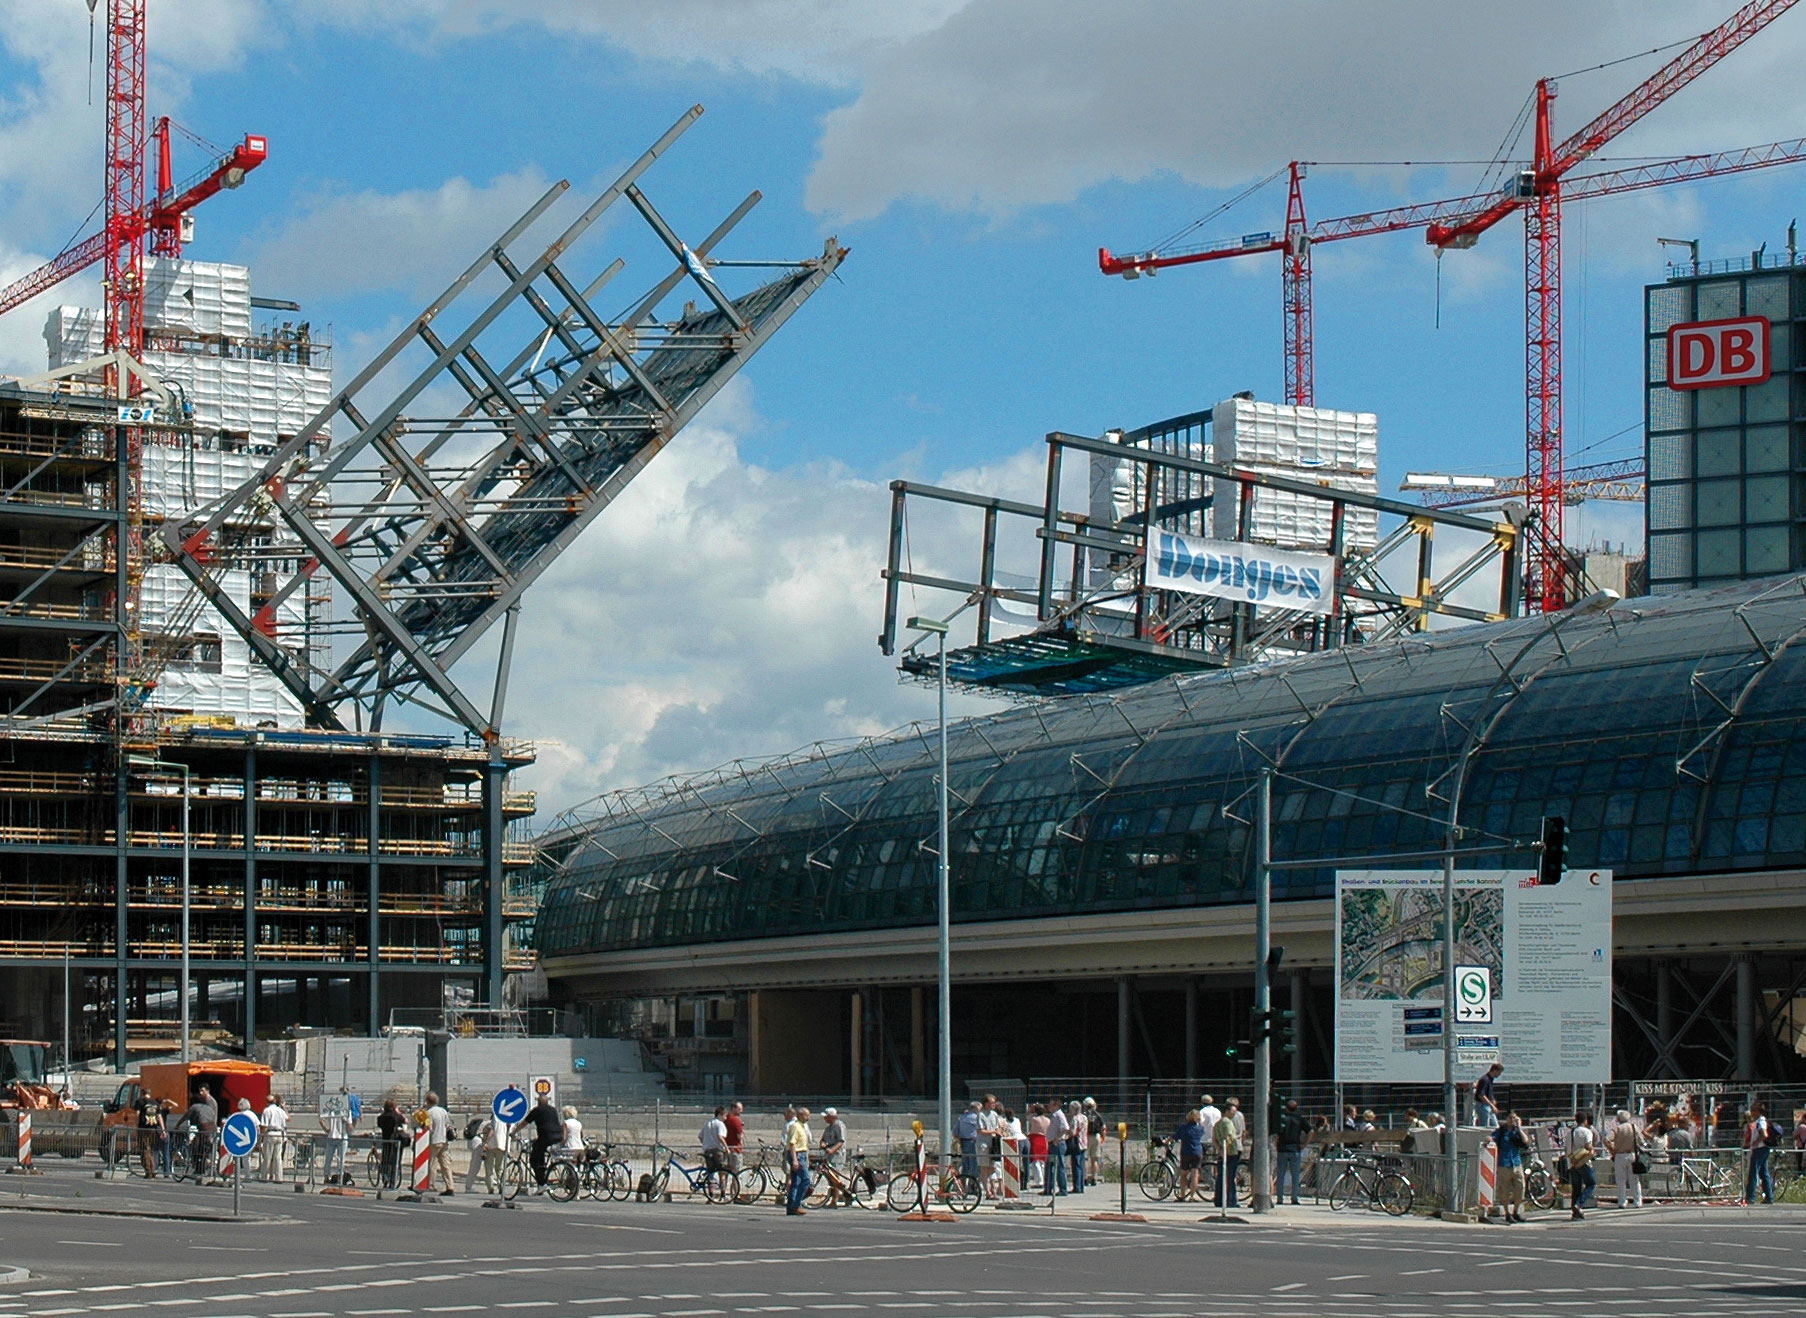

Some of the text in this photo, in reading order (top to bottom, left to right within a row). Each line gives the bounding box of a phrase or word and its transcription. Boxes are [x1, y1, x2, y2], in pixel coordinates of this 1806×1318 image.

[1680, 329, 1756, 378] DB
[1158, 533, 1321, 601] Donges
[1460, 971, 1487, 1005] S
[1635, 1083, 1653, 1094] KISS
[1655, 1083, 1668, 1094] ME
[1705, 1082, 1723, 1094] KISS
